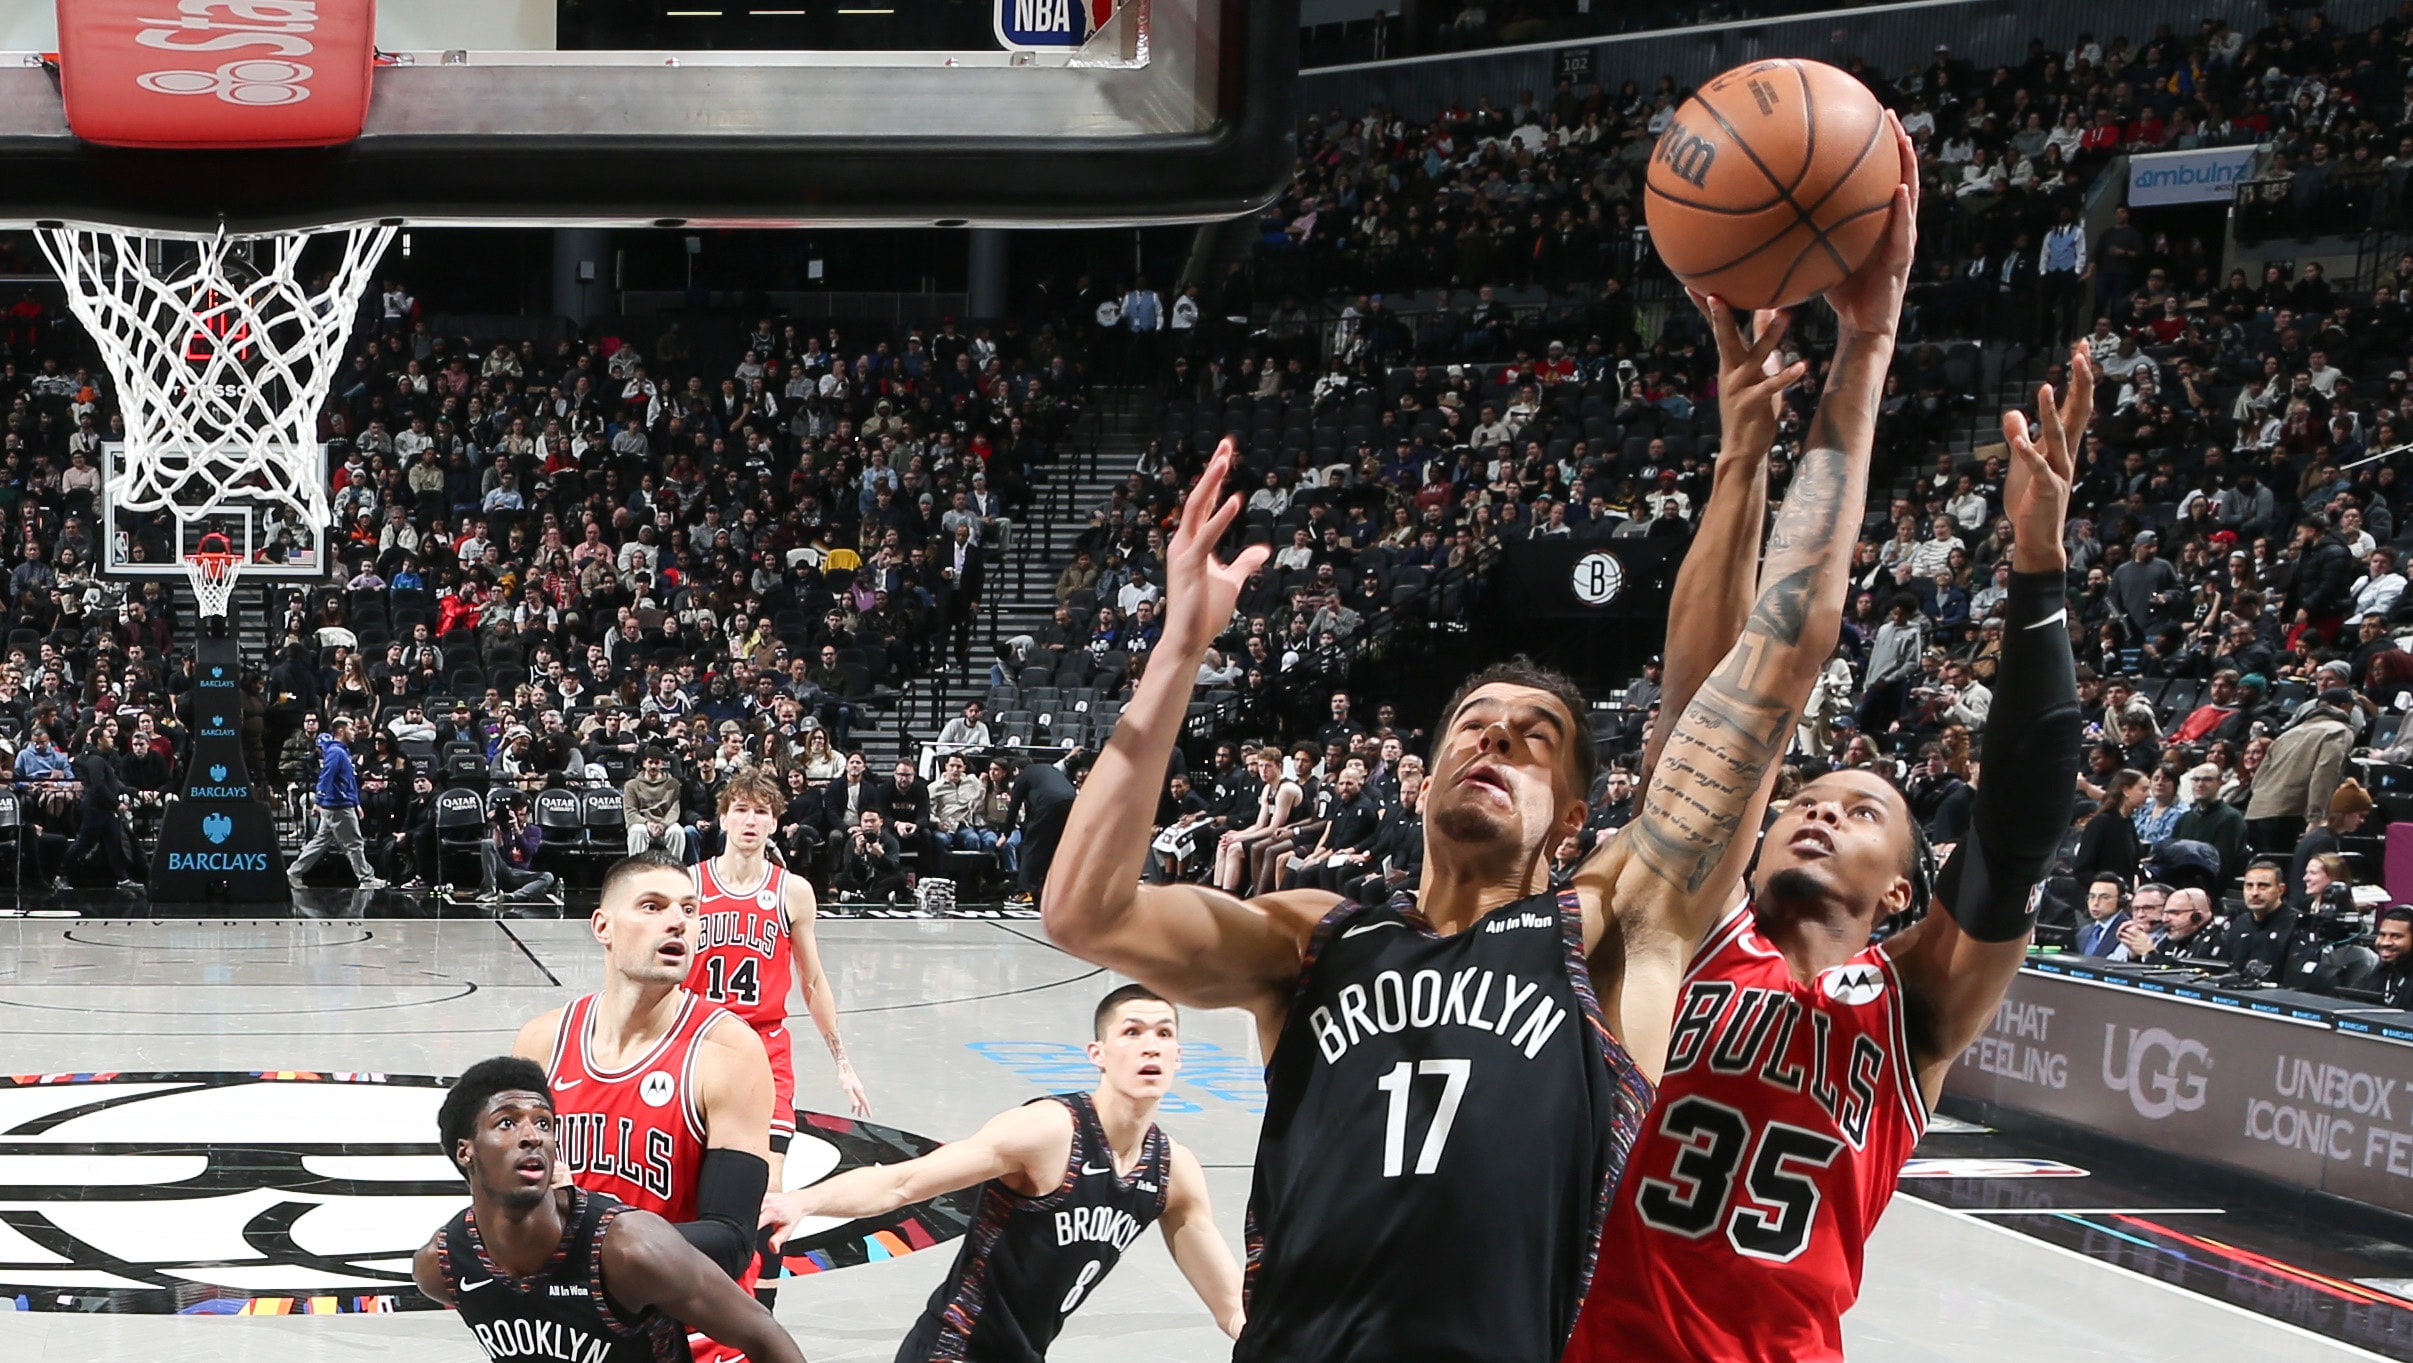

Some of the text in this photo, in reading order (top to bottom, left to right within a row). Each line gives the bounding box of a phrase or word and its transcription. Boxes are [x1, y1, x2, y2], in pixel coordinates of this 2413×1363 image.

[1014, 0, 1070, 32] NBA
[1564, 58, 1588, 71] 102
[2135, 161, 2248, 188] ambulnz
[1590, 560, 1605, 596] B
[200, 680, 234, 688] BARCLAYS
[190, 787, 247, 797] BARCLAYS
[443, 796, 476, 808] QATAR
[541, 797, 574, 808] QATAR
[589, 795, 622, 807] QATAR
[168, 853, 267, 871] BARCLAYS
[696, 911, 778, 960] BULLS
[1486, 913, 1552, 933] All In Won
[706, 955, 759, 1005] 14
[1309, 966, 1567, 1065] BROOKLYN
[1994, 999, 2055, 1041] THAT
[1663, 981, 1885, 1152] BULLS
[1963, 1035, 2068, 1089] FEELING
[2102, 1023, 2209, 1120] UGG
[2275, 1054, 2396, 1121] UNBOX
[1378, 1059, 1472, 1177] 17
[2244, 1098, 2355, 1160] ICONIC
[1634, 1094, 1846, 1264] 35
[1060, 1260, 1101, 1313] 8
[473, 1318, 612, 1363] ROOKLYN
